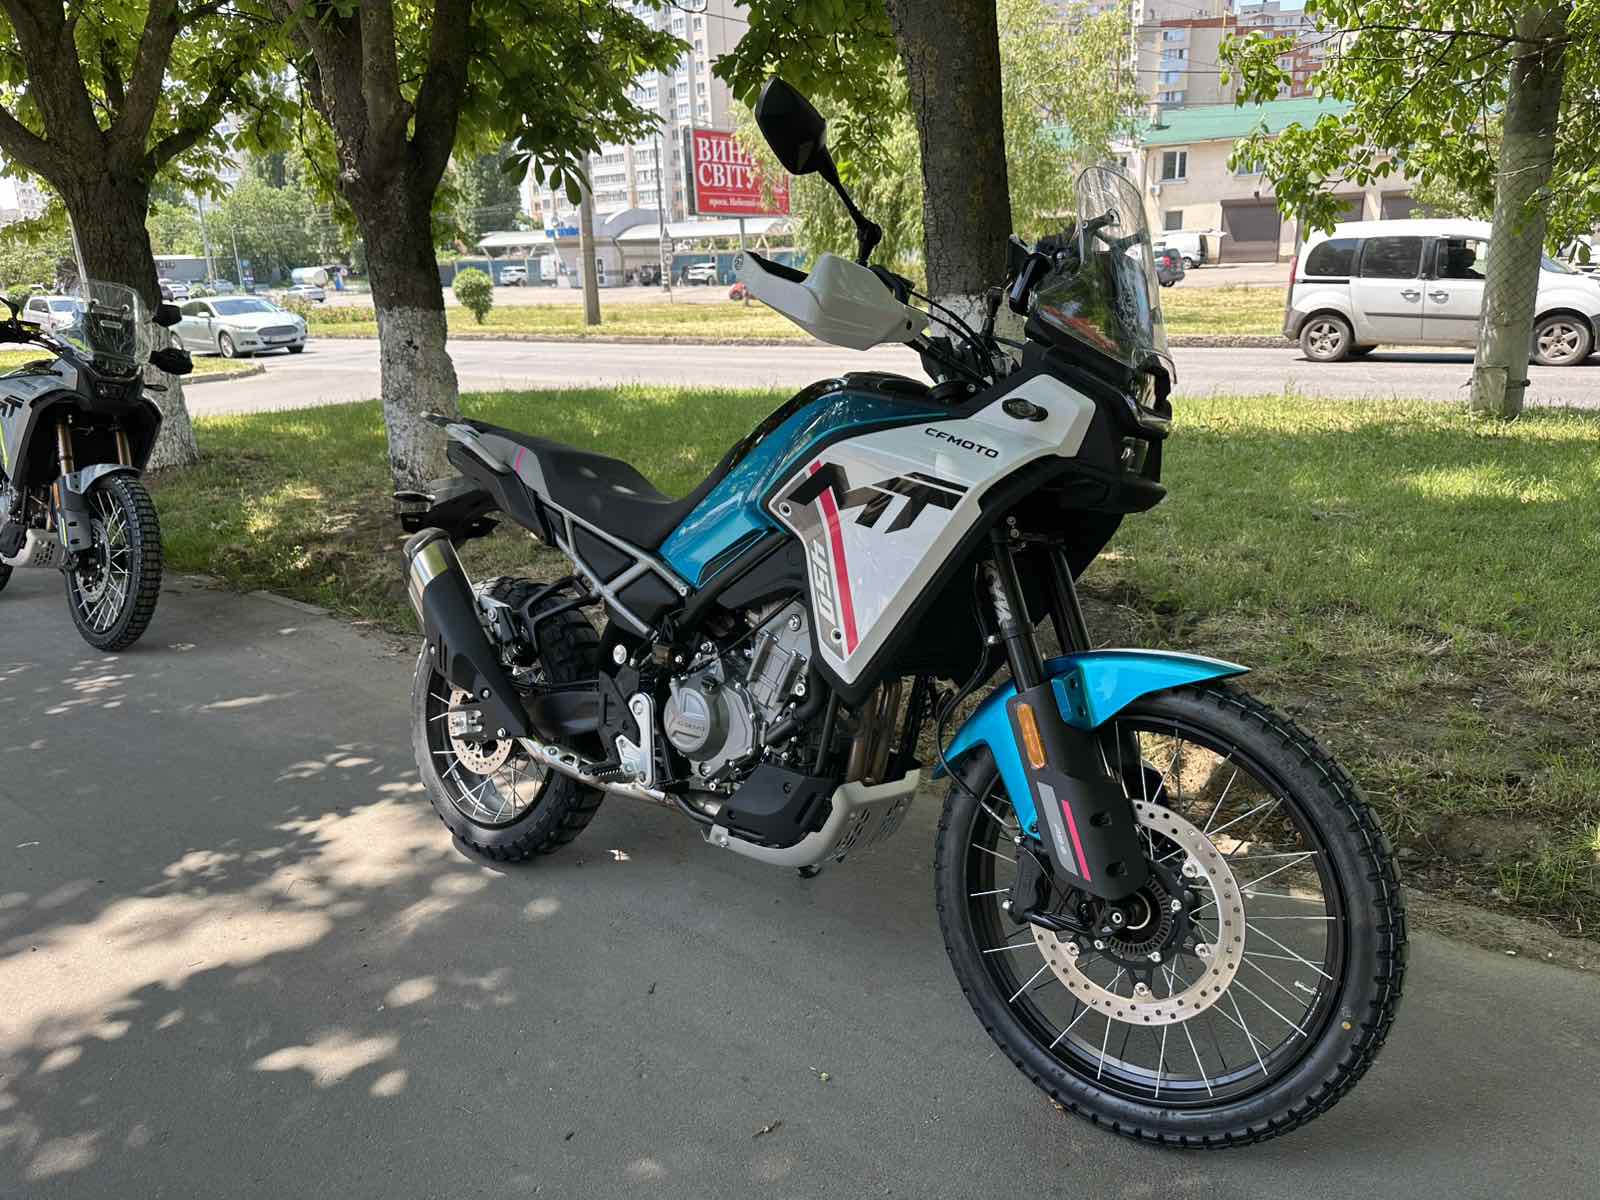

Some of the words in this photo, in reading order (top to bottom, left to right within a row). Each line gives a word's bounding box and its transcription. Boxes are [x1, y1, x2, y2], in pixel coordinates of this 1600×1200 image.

[698, 162, 754, 190] СВІТУ
[925, 427, 999, 458] CFMOTO
[811, 541, 834, 625] 450
